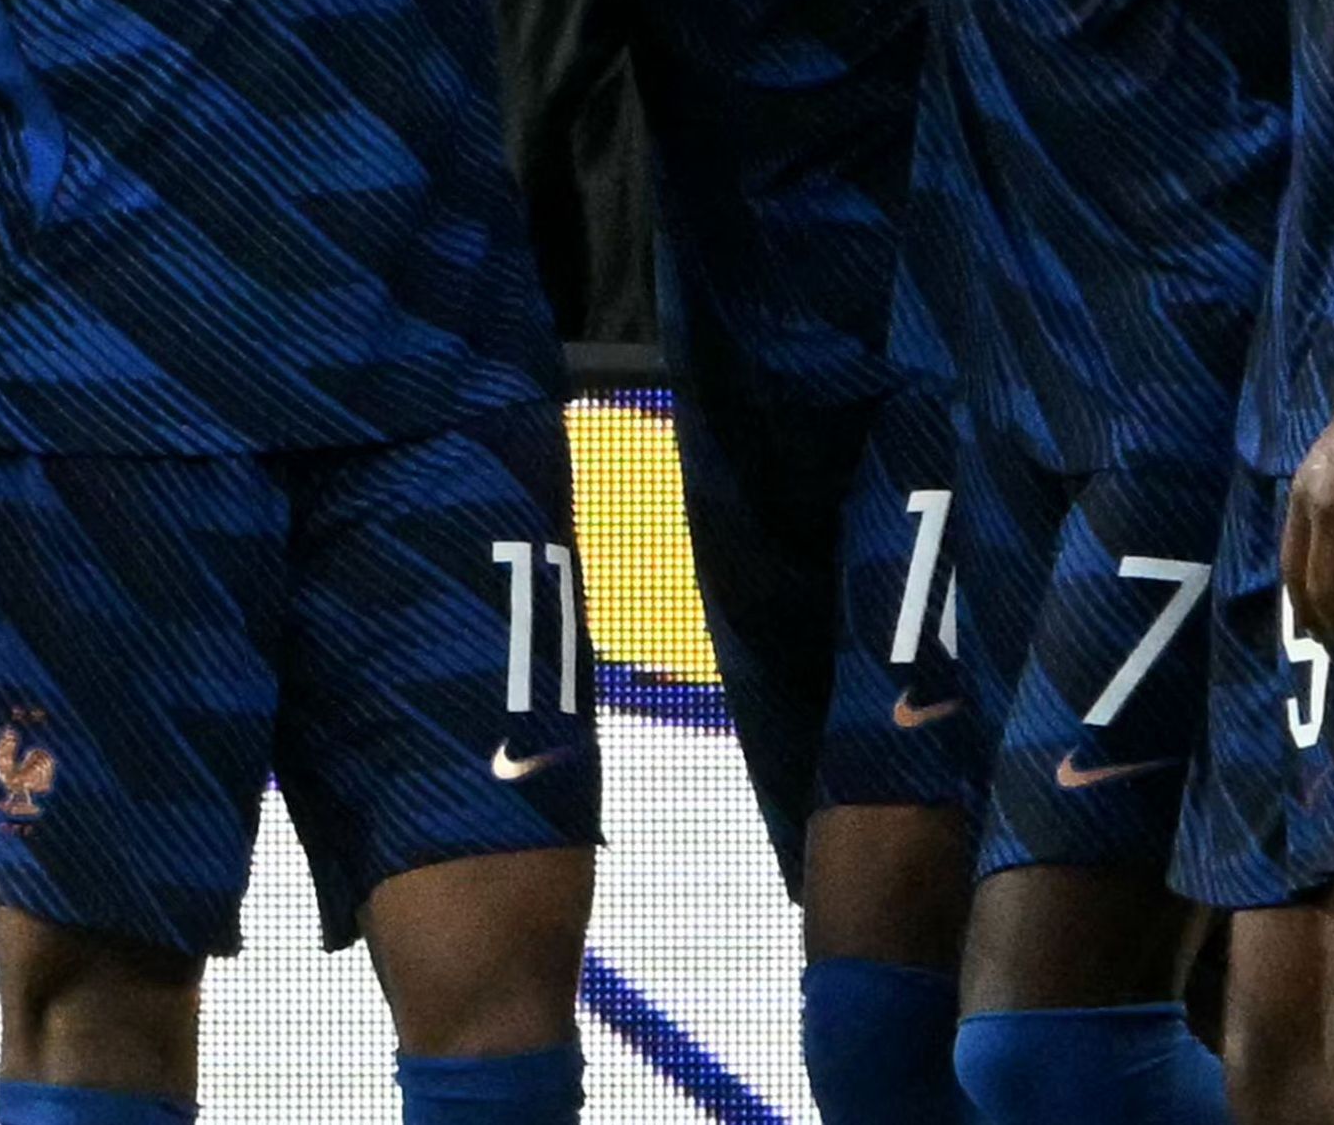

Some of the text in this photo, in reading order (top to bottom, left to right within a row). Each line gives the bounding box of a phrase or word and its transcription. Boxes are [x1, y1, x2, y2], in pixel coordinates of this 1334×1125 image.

[492, 541, 577, 714] 11
[890, 489, 957, 663] 1
[1082, 555, 1212, 726] 7
[1281, 583, 1331, 749] 5
